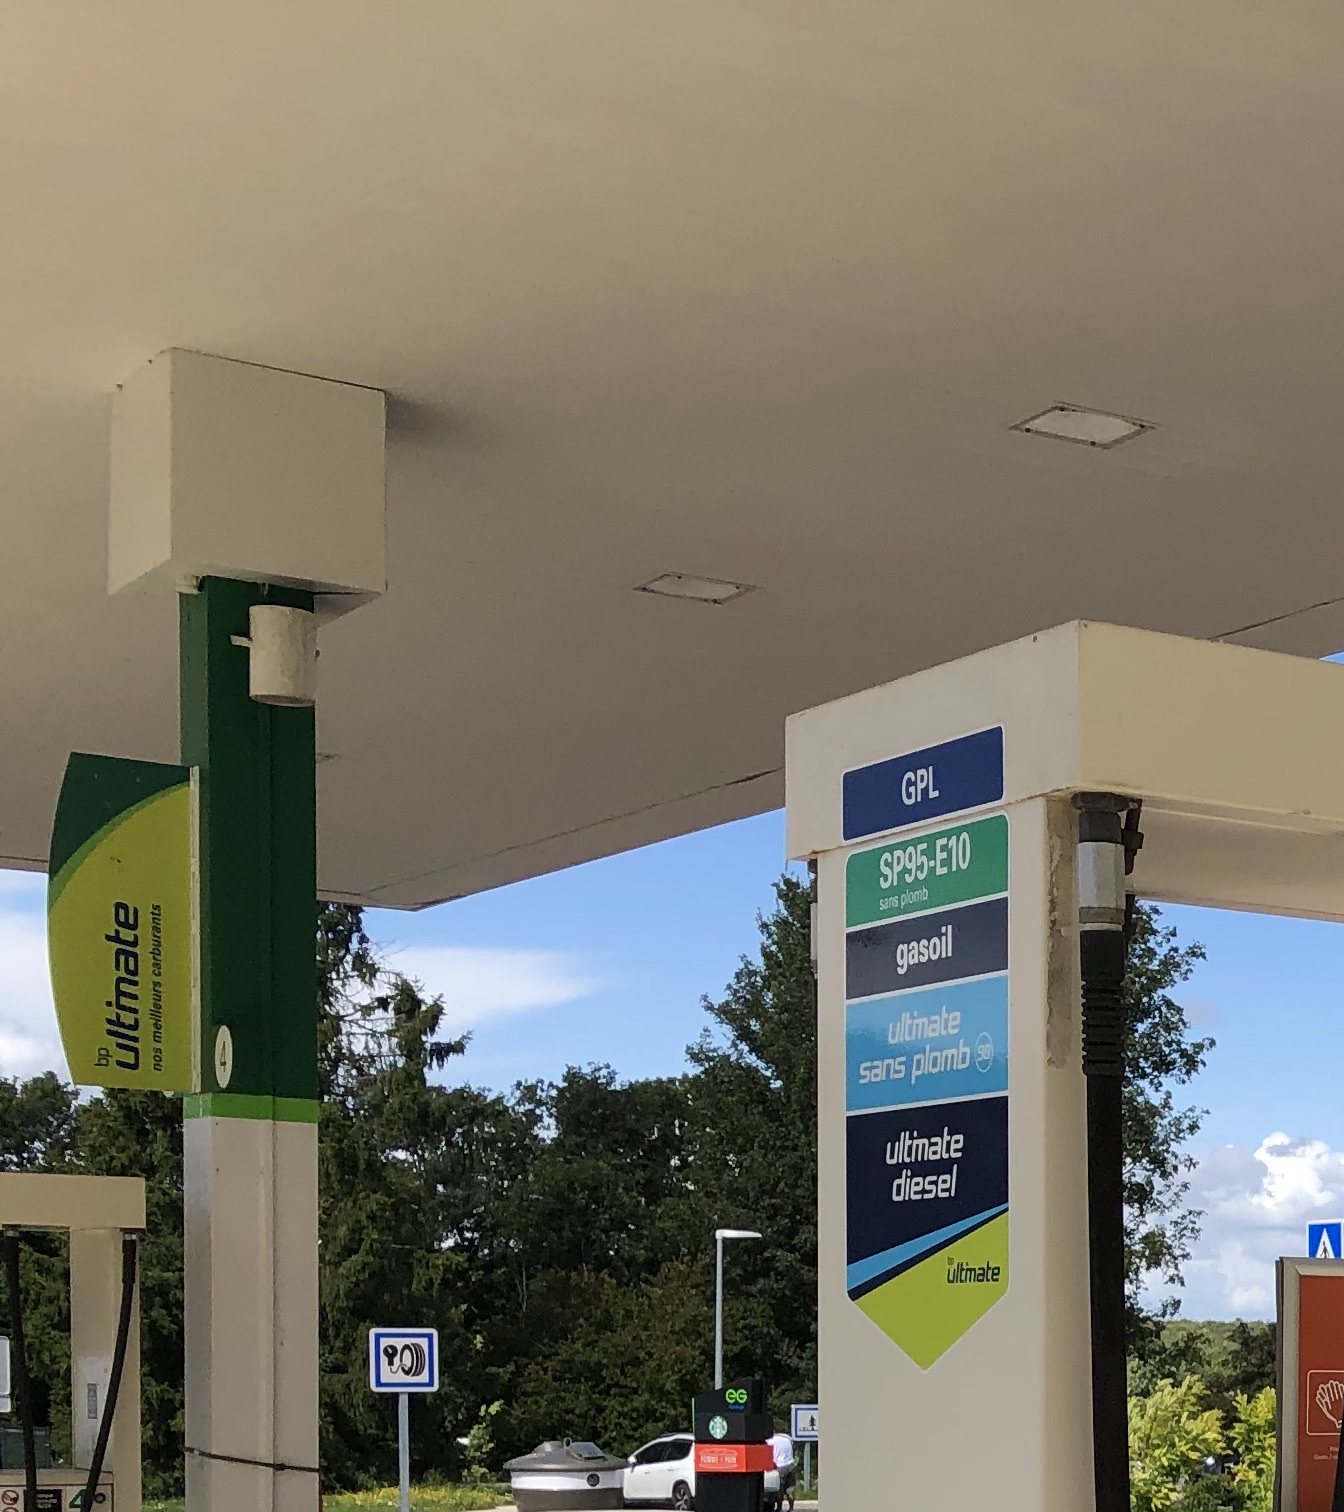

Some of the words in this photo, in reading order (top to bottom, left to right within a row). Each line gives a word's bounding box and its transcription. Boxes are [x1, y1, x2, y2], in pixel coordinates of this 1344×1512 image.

[902, 766, 939, 805] GPL
[880, 832, 970, 889] SP95-E10
[879, 894, 899, 911] sans
[901, 886, 928, 909] plomb
[149, 903, 162, 976] carburants
[897, 925, 952, 974] gasoil
[105, 901, 140, 1071] ultimate
[150, 981, 163, 1043] meilleurs
[888, 1006, 961, 1046] ultimate
[94, 1047, 113, 1067] bp
[153, 1047, 163, 1072] nos
[219, 1040, 227, 1072] 4
[859, 1057, 905, 1085] sans
[912, 1041, 970, 1085] plomb
[887, 1126, 964, 1166] ultimate
[892, 1165, 957, 1202] diesel
[947, 1260, 1001, 1284] ultimate
